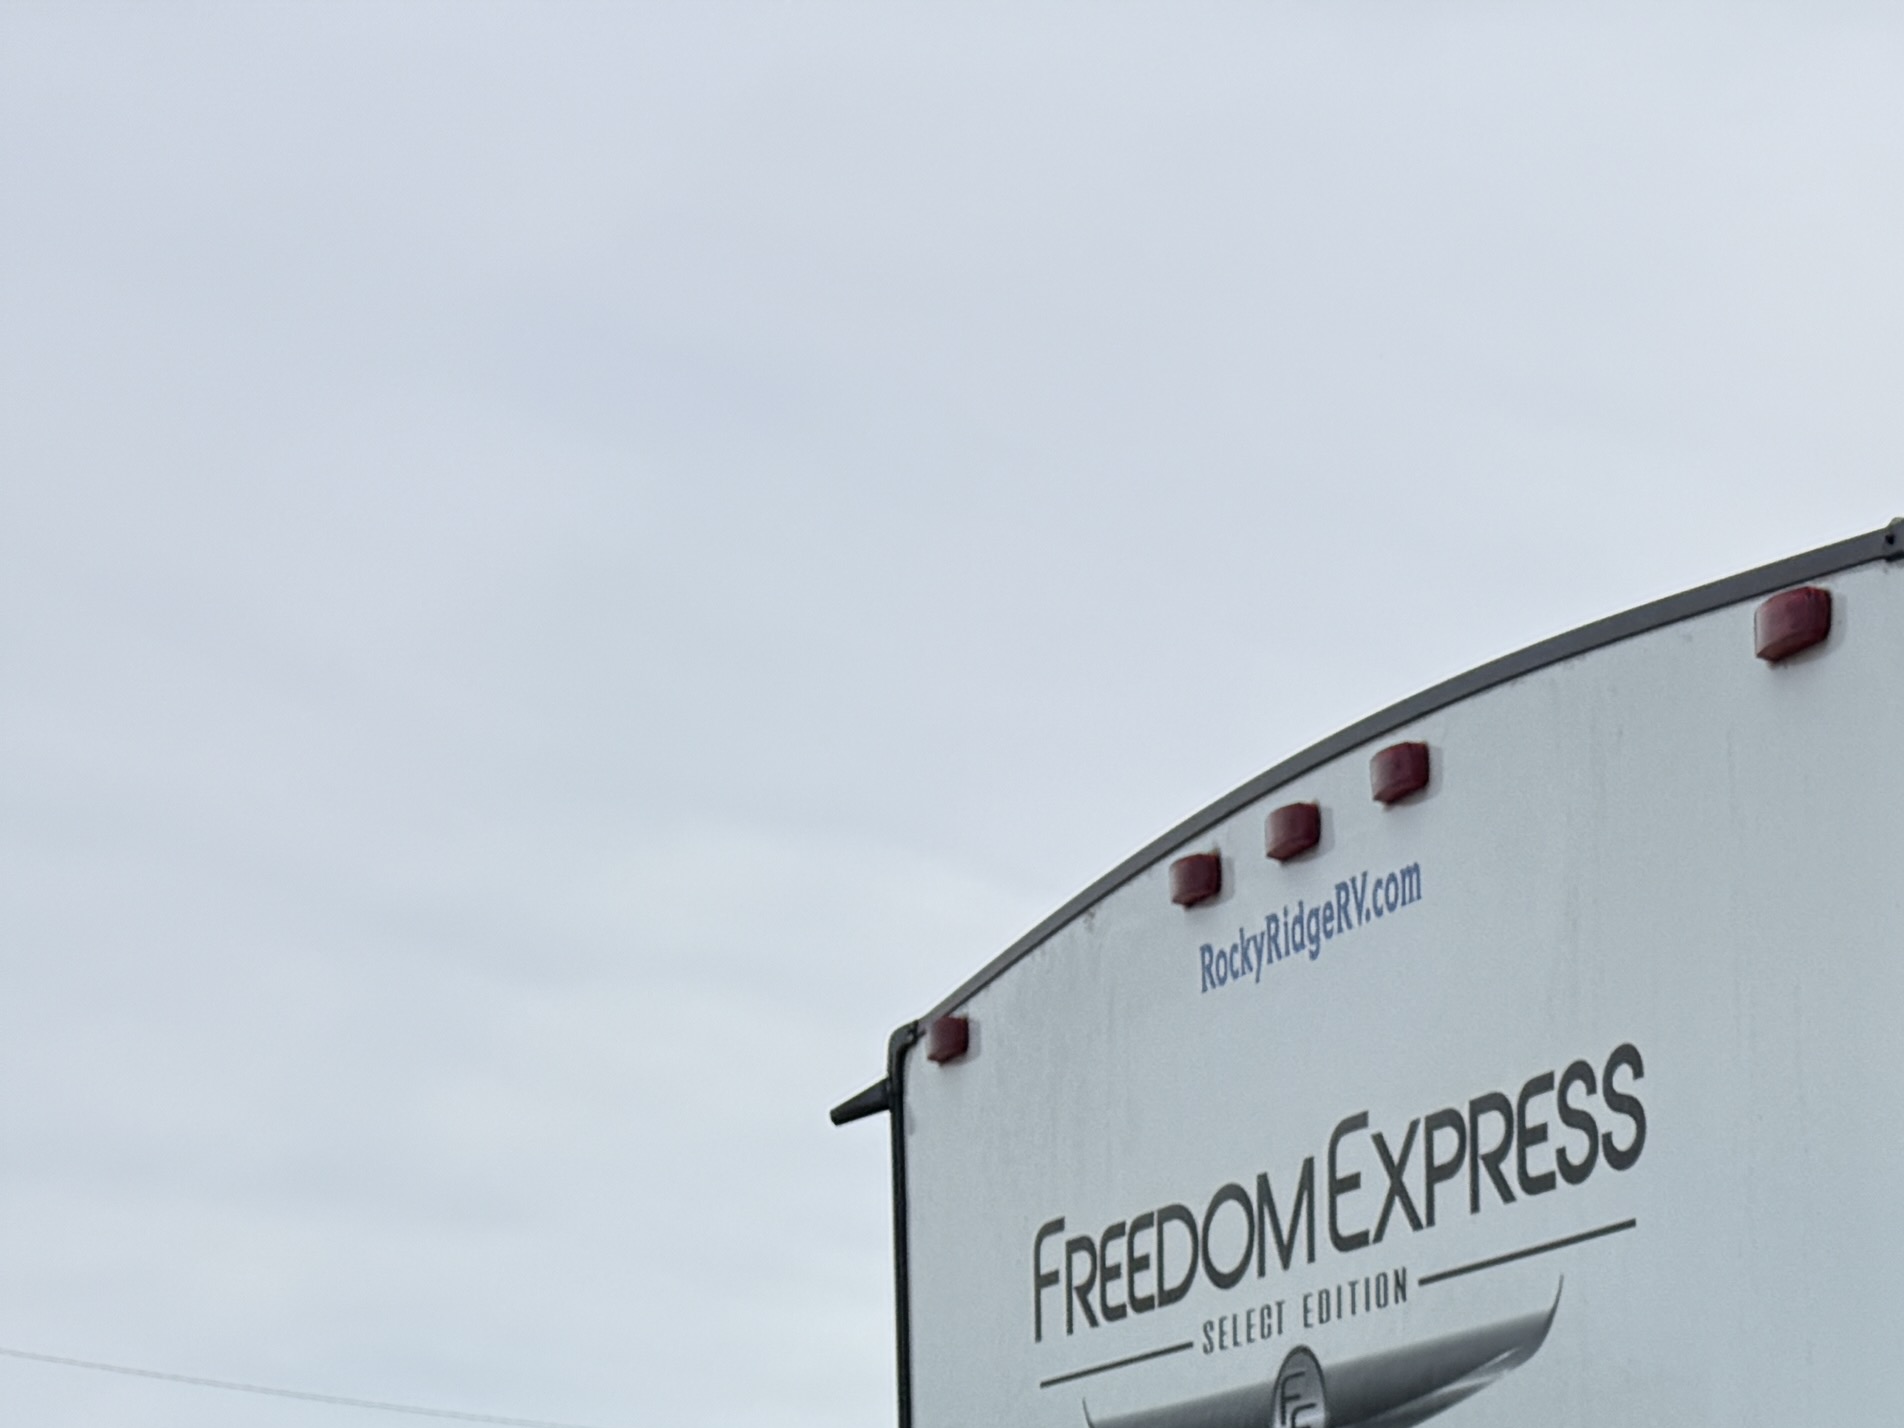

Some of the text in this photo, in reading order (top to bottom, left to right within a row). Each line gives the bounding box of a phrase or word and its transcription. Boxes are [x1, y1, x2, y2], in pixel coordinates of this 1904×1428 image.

[1199, 861, 1422, 994] RockyRidgeRV.com
[1202, 1266, 1407, 1355] SELECT EDITION
